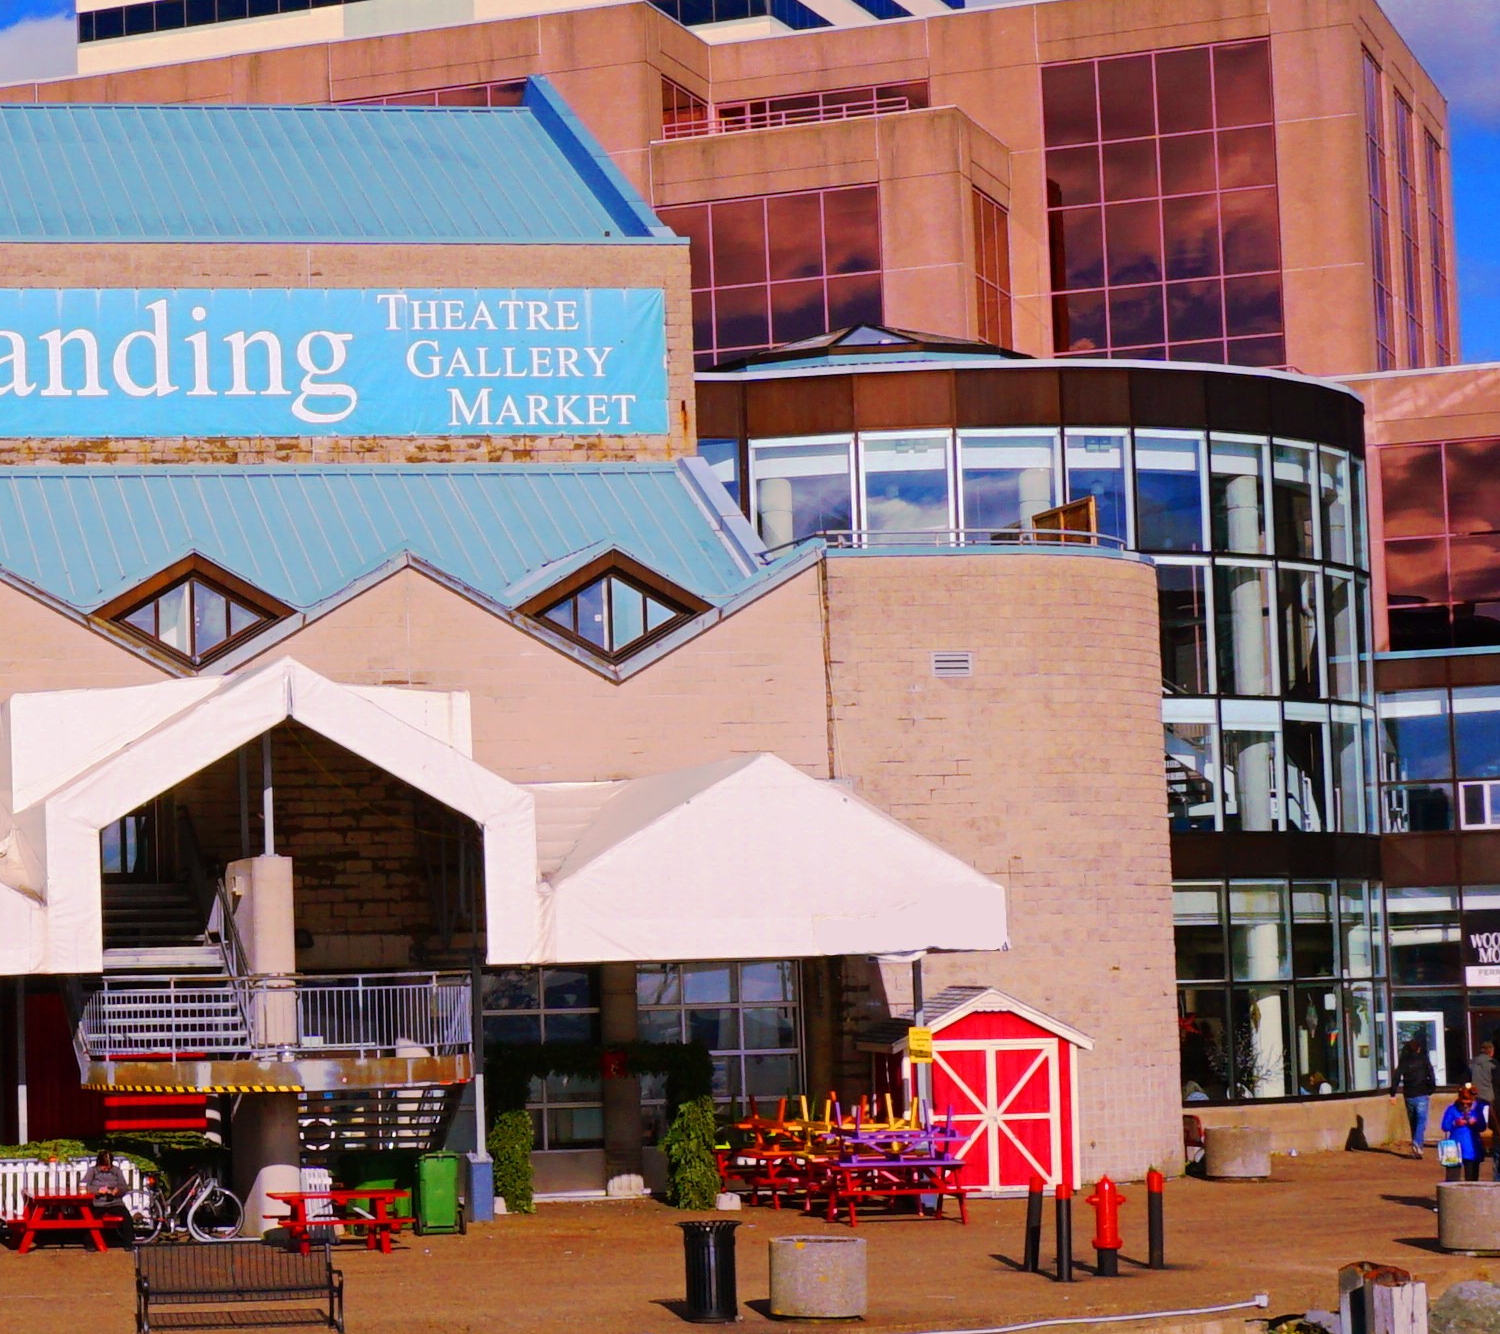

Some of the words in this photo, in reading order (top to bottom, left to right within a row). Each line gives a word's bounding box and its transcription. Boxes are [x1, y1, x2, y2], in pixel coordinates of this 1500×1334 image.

[376, 293, 580, 331] THEATRE
[405, 339, 614, 379] GALLERY
[445, 387, 637, 427] MARKET
